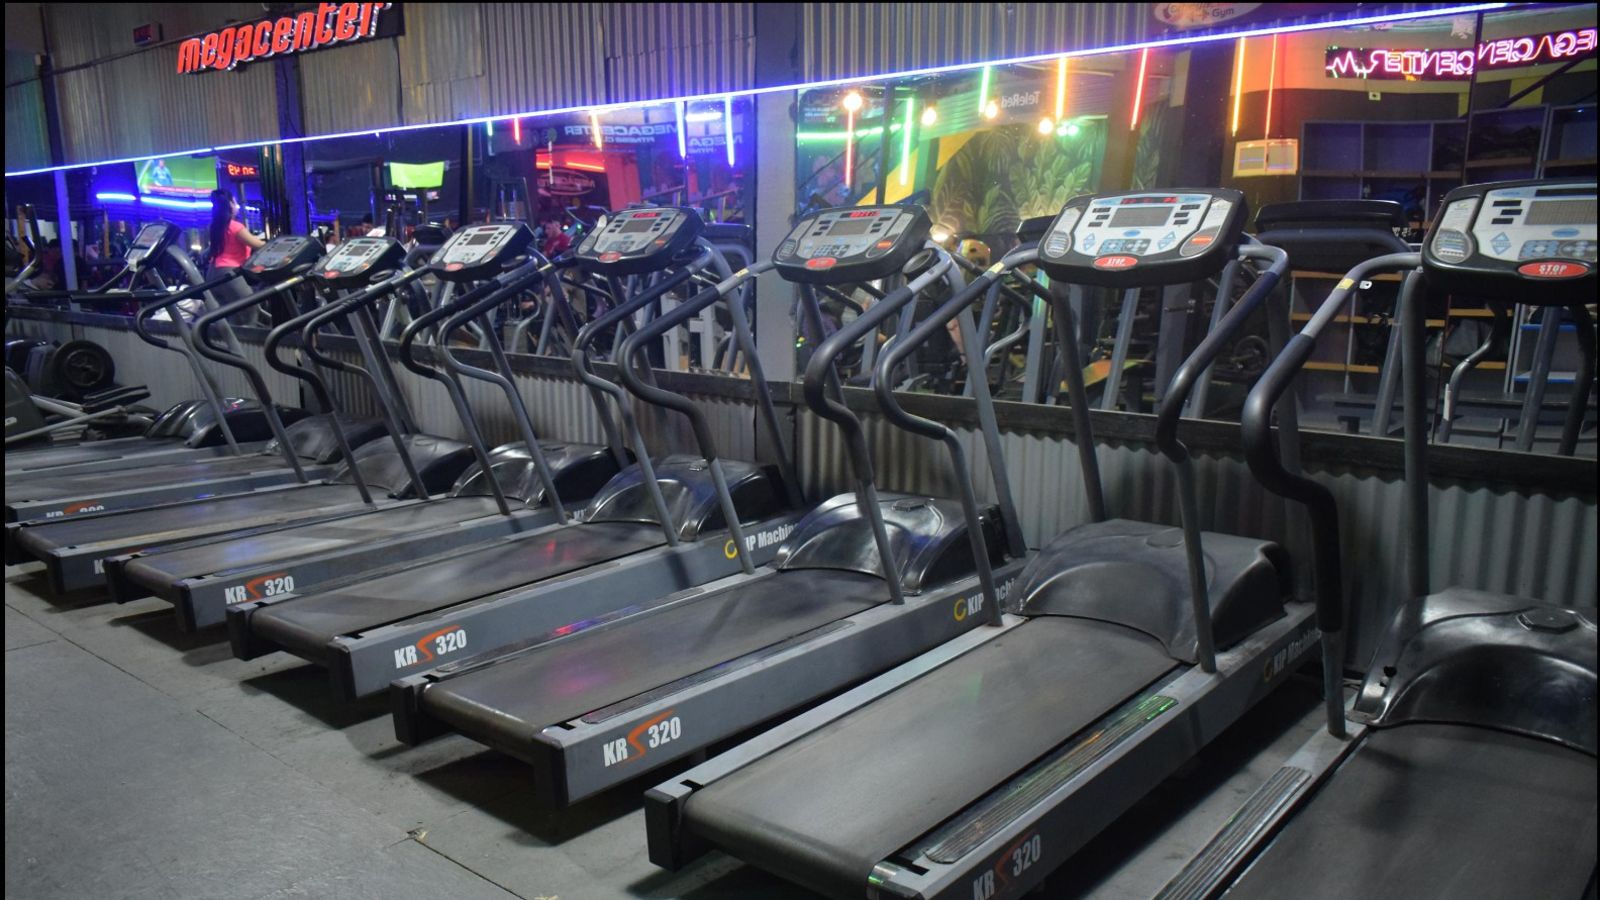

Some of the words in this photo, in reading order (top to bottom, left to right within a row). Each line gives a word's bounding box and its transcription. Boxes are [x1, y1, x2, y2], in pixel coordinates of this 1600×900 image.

[177, 3, 387, 74] megacenter
[1538, 264, 1567, 273] STOP
[264, 575, 295, 597] 320
[435, 629, 467, 655] 320
[648, 716, 681, 749] 320
[1012, 833, 1041, 877] 320
